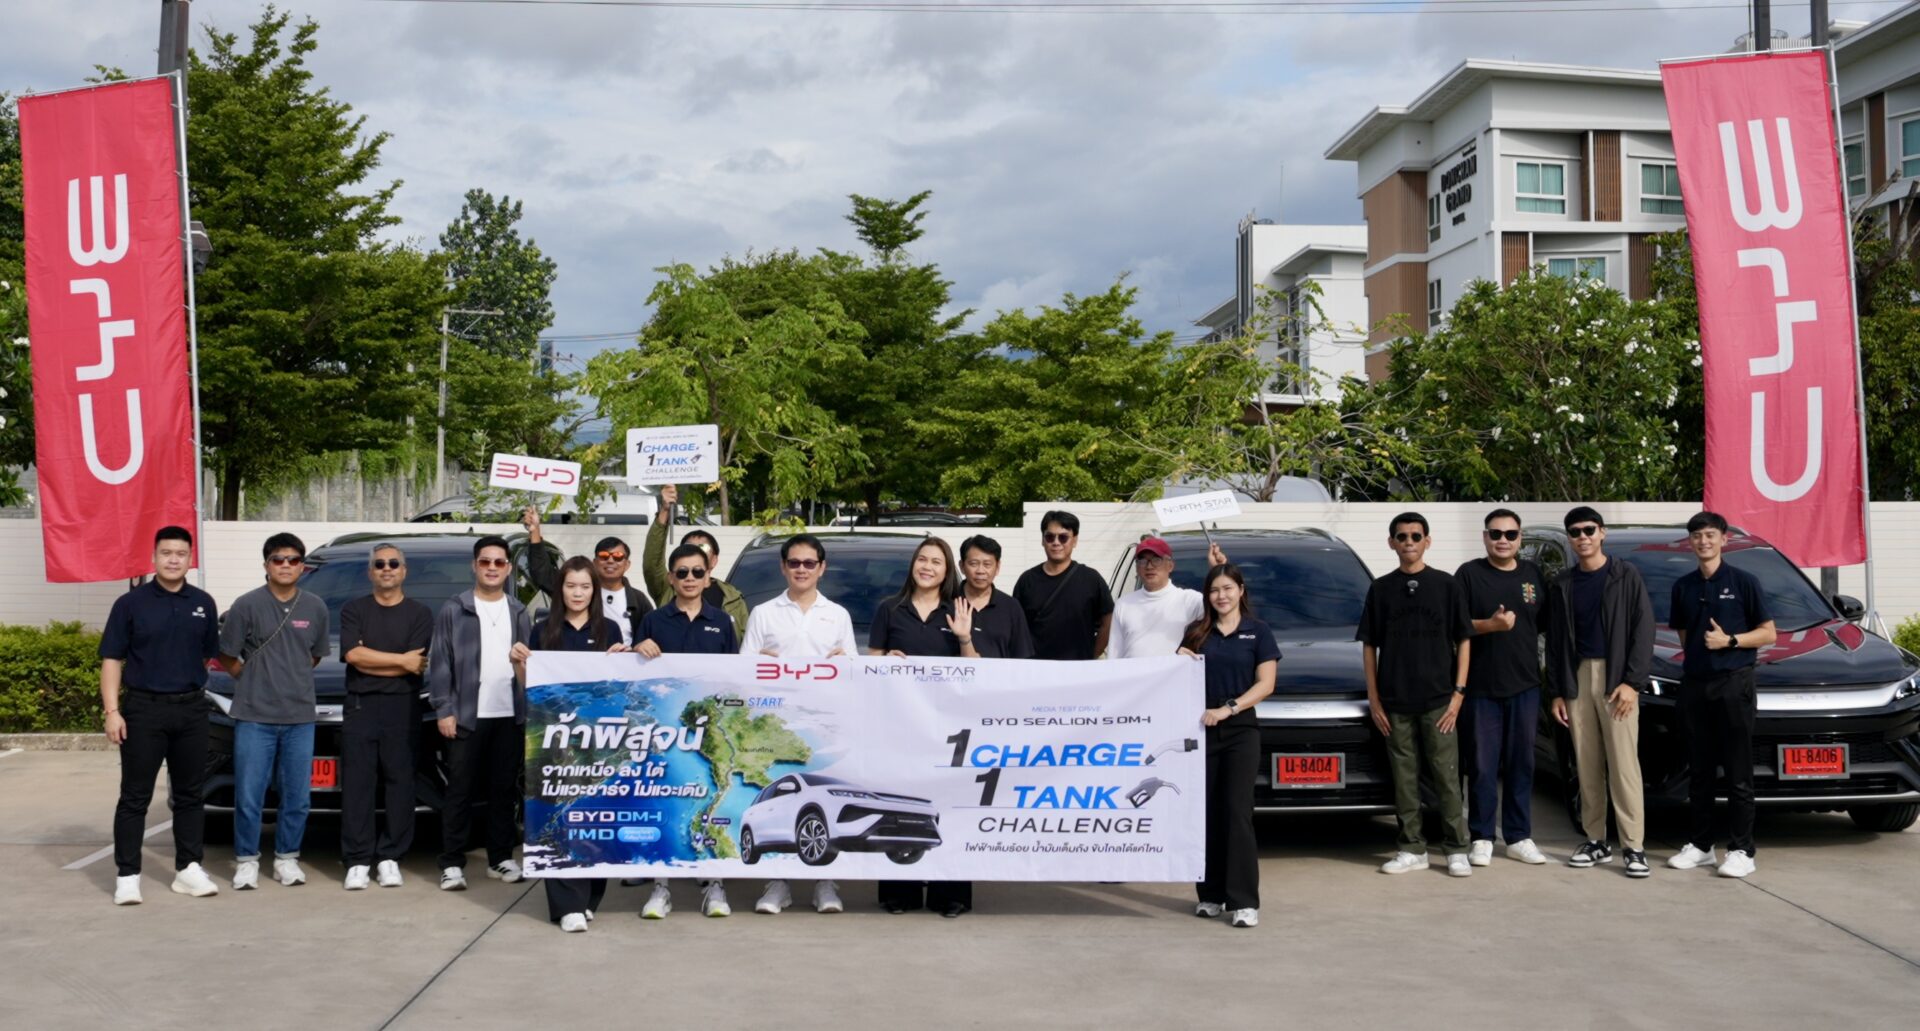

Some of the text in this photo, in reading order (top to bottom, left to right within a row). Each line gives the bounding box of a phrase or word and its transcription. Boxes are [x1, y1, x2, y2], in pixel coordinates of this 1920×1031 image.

[1446, 183, 1472, 213] GRAND
[1718, 117, 1822, 502] BYD
[68, 173, 144, 485] BYD
[645, 466, 699, 474] CHALLENGE
[656, 457, 689, 465] TANK
[496, 462, 575, 485] BYD
[1204, 496, 1232, 508] STAR
[756, 663, 976, 680] BYD NORTH STAR
[748, 696, 784, 707] START
[982, 717, 1018, 726] BYD
[1023, 717, 1098, 726] SEALION
[542, 712, 708, 763] ท้าพิสูจน์
[946, 729, 1144, 768] 1 CHARGE
[541, 760, 667, 777] จากเหนือ ลง ใต้
[541, 780, 707, 798] ไม่แวะชาร์จ ไม่แวะเติม
[975, 768, 1121, 809] 1 TANK
[978, 816, 1153, 834] CHALLENGE
[965, 841, 1030, 853] ไฟฟ้าเต็มร้อย
[1031, 840, 1088, 853] น้ำมันเต็มถัง
